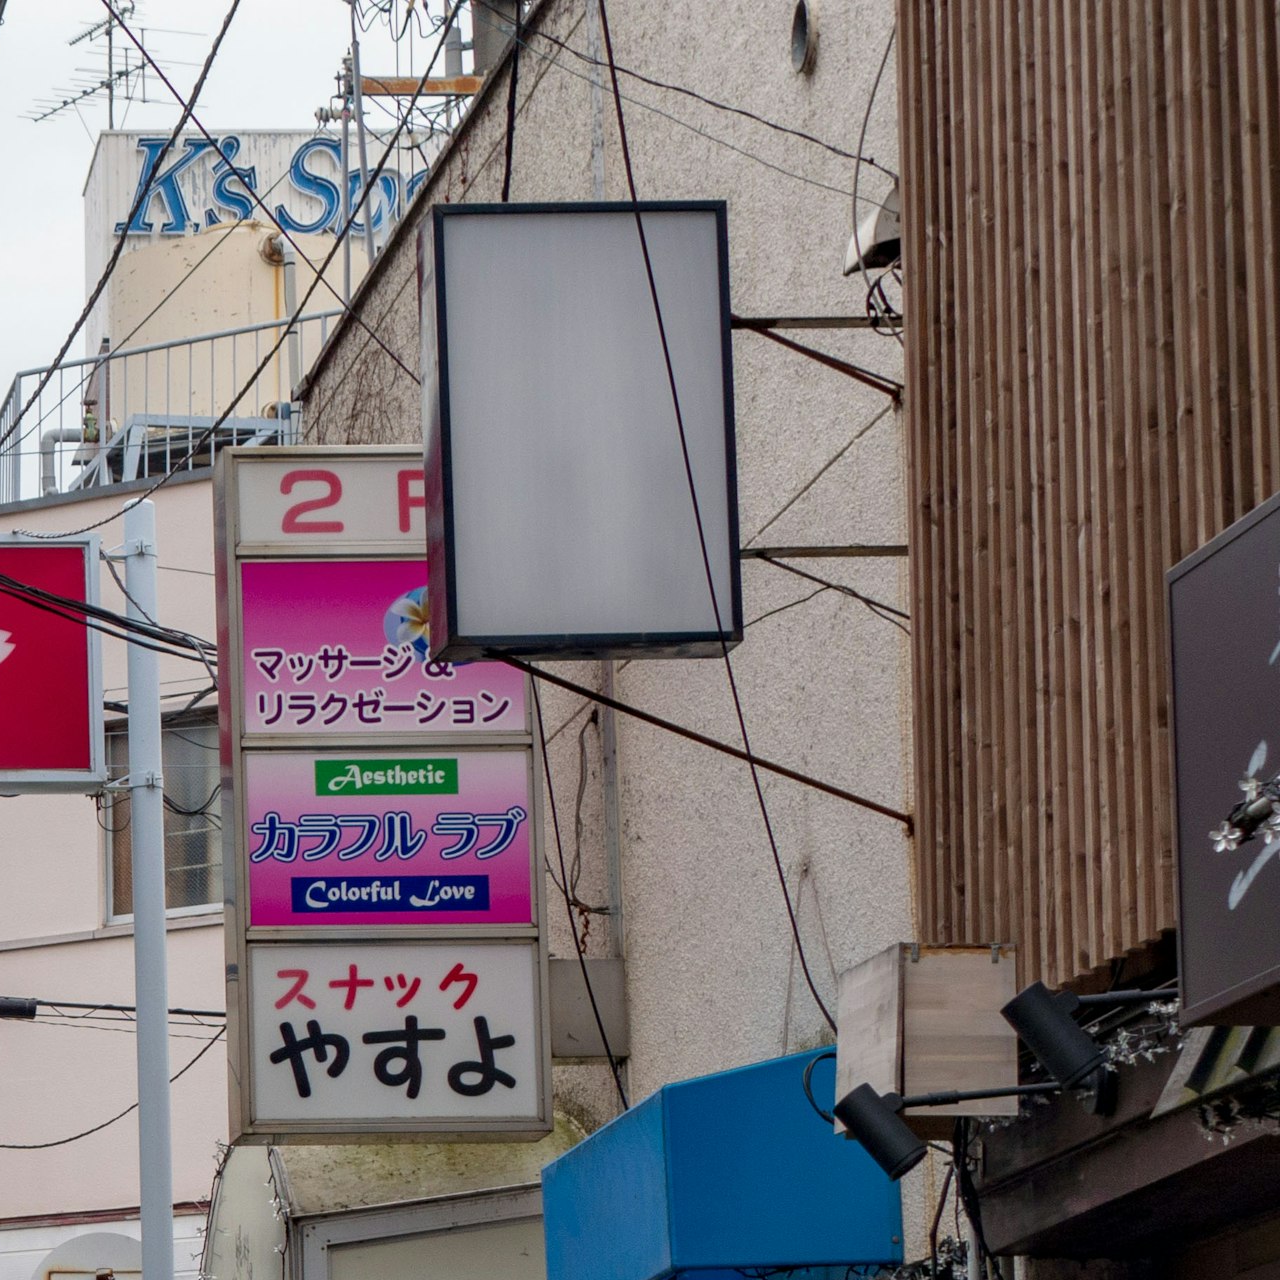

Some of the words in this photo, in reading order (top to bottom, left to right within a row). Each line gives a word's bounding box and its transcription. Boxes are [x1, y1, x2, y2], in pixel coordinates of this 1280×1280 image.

[114, 135, 258, 236] K's
[257, 690, 510, 726] リラクゼーション
[327, 763, 446, 791] Aesthetic
[304, 880, 401, 908] Colorful
[408, 878, 476, 908] Love
[274, 963, 479, 1011] スナック
[269, 1015, 517, 1099] やすよ
